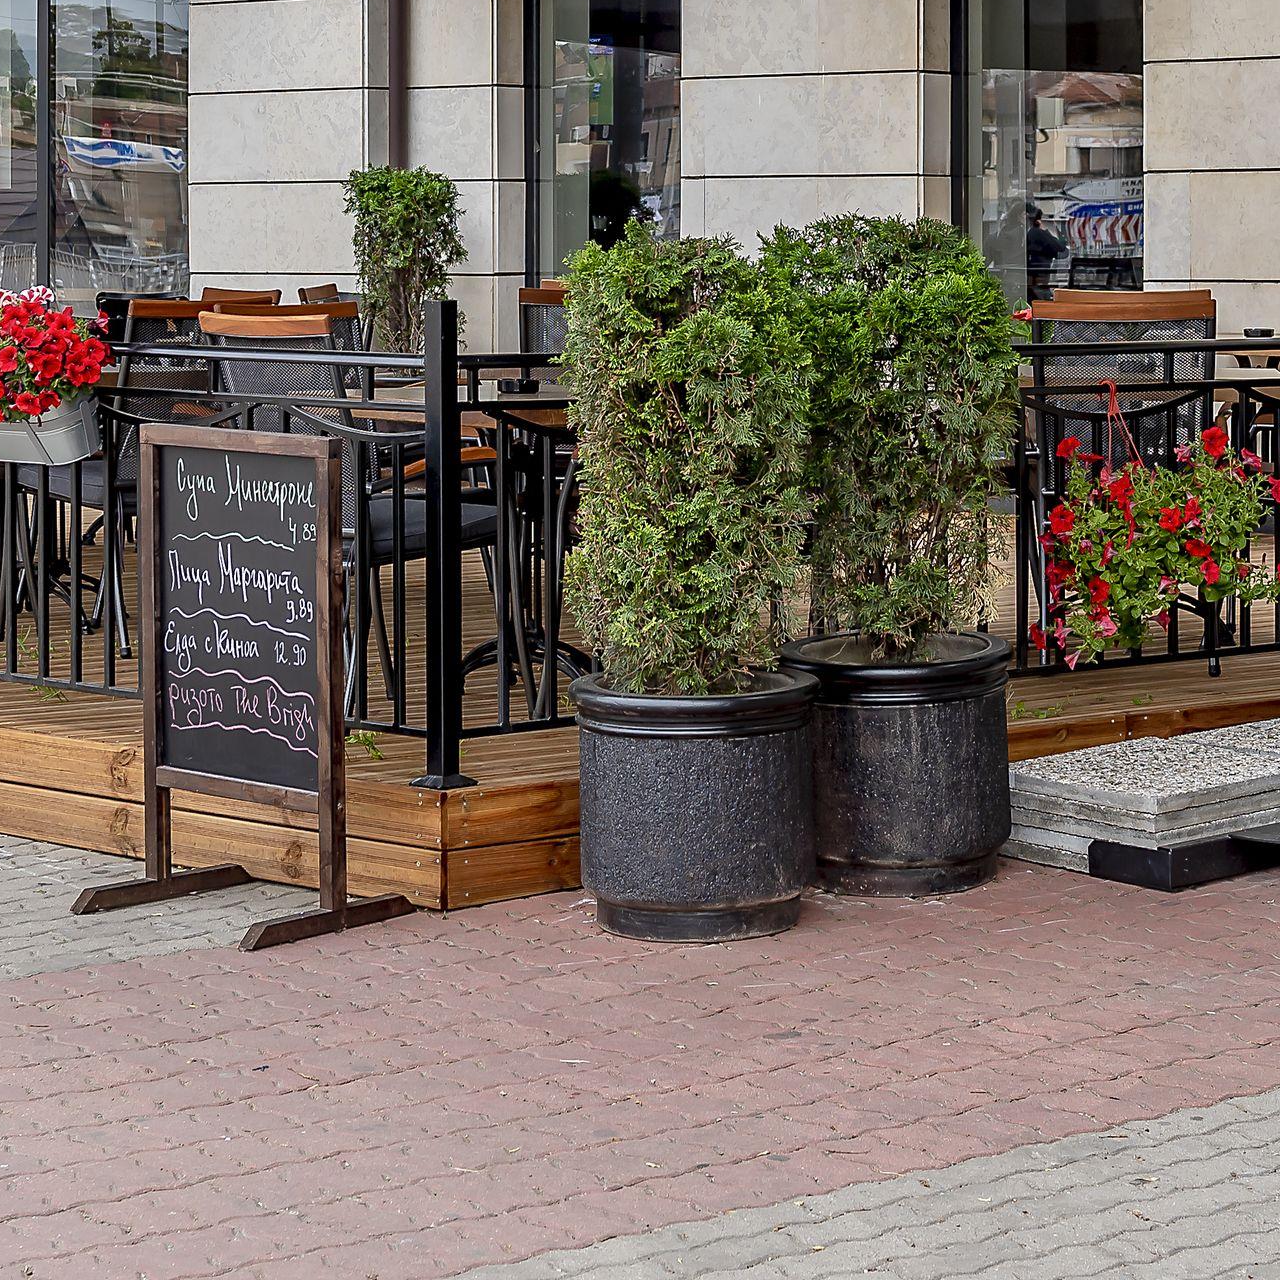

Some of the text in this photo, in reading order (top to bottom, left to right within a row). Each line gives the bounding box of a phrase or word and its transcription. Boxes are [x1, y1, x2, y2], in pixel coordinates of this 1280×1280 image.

[177, 454, 316, 521] Супа Минестроне
[288, 517, 317, 545] 4.89
[168, 541, 304, 605] Пица Маргарита
[285, 598, 313, 623] 9.89
[273, 640, 307, 666] 12.90
[230, 685, 262, 718] The
